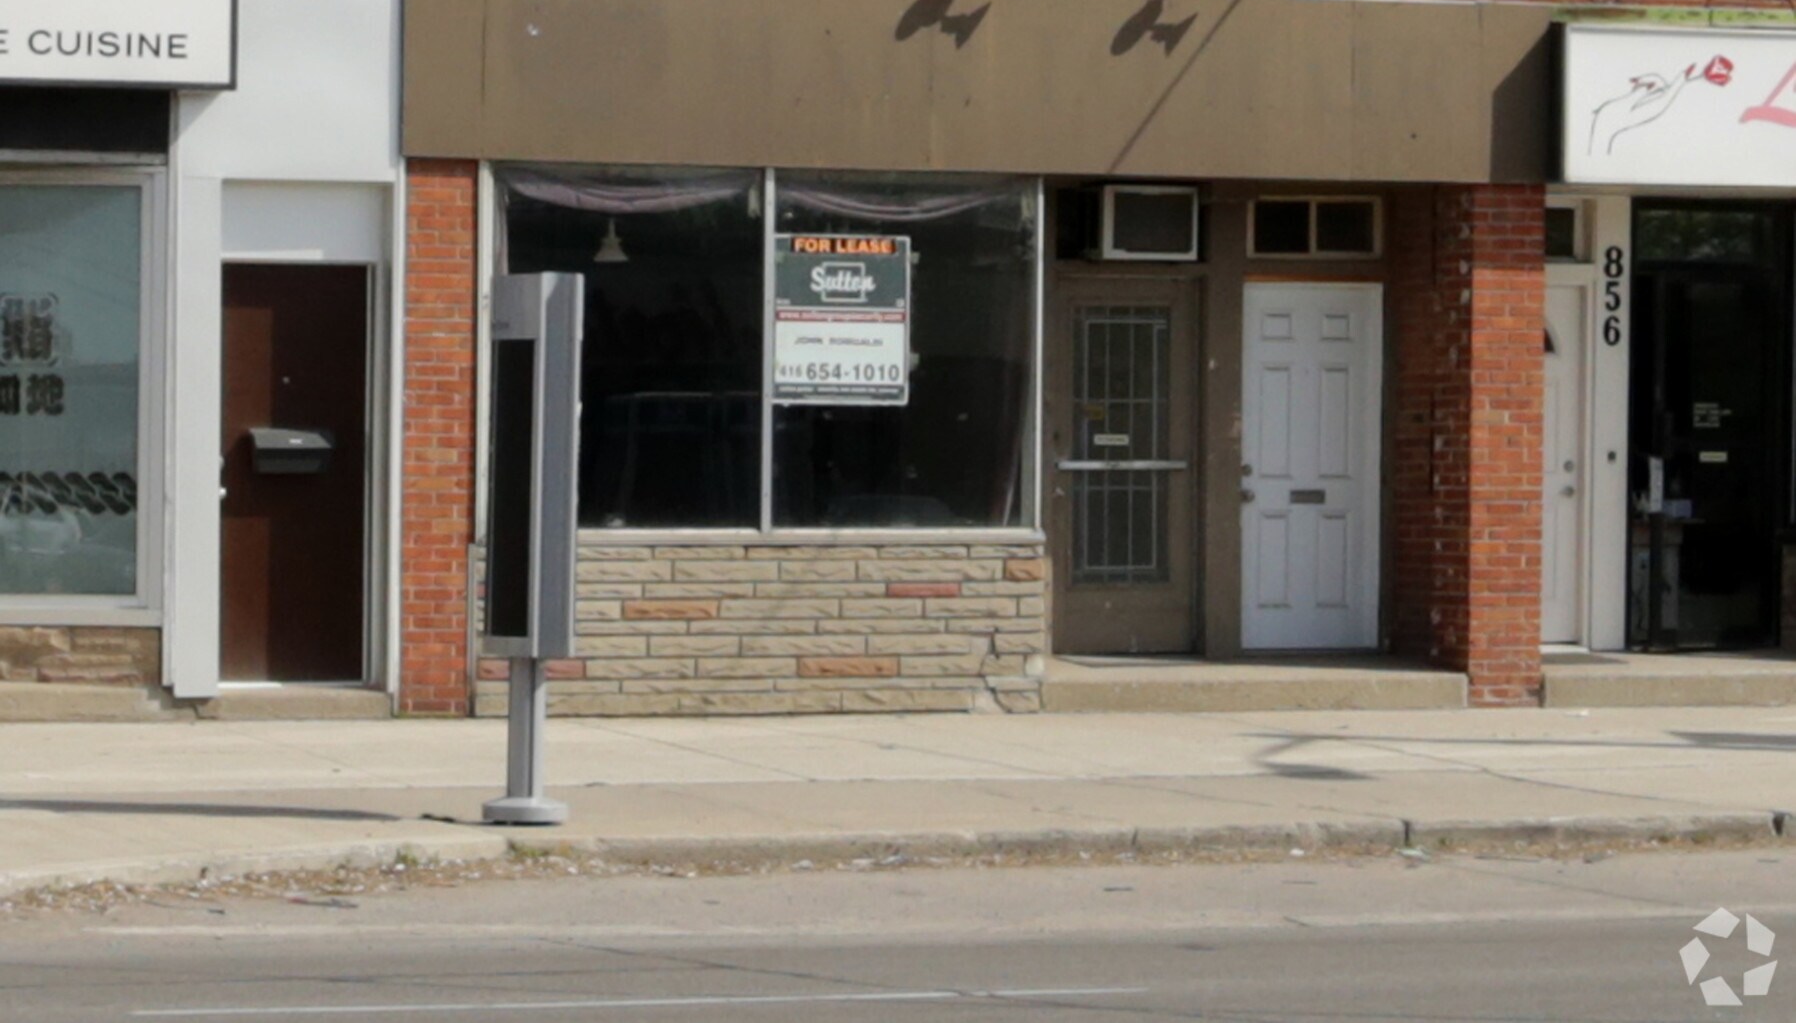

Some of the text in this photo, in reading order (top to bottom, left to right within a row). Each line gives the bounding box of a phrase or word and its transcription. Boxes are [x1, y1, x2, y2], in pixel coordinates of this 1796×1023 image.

[28, 29, 188, 59] CUISINE
[793, 238, 893, 254] FOR LEASE
[1603, 246, 1624, 346] 856
[806, 363, 900, 382] 654-1010
